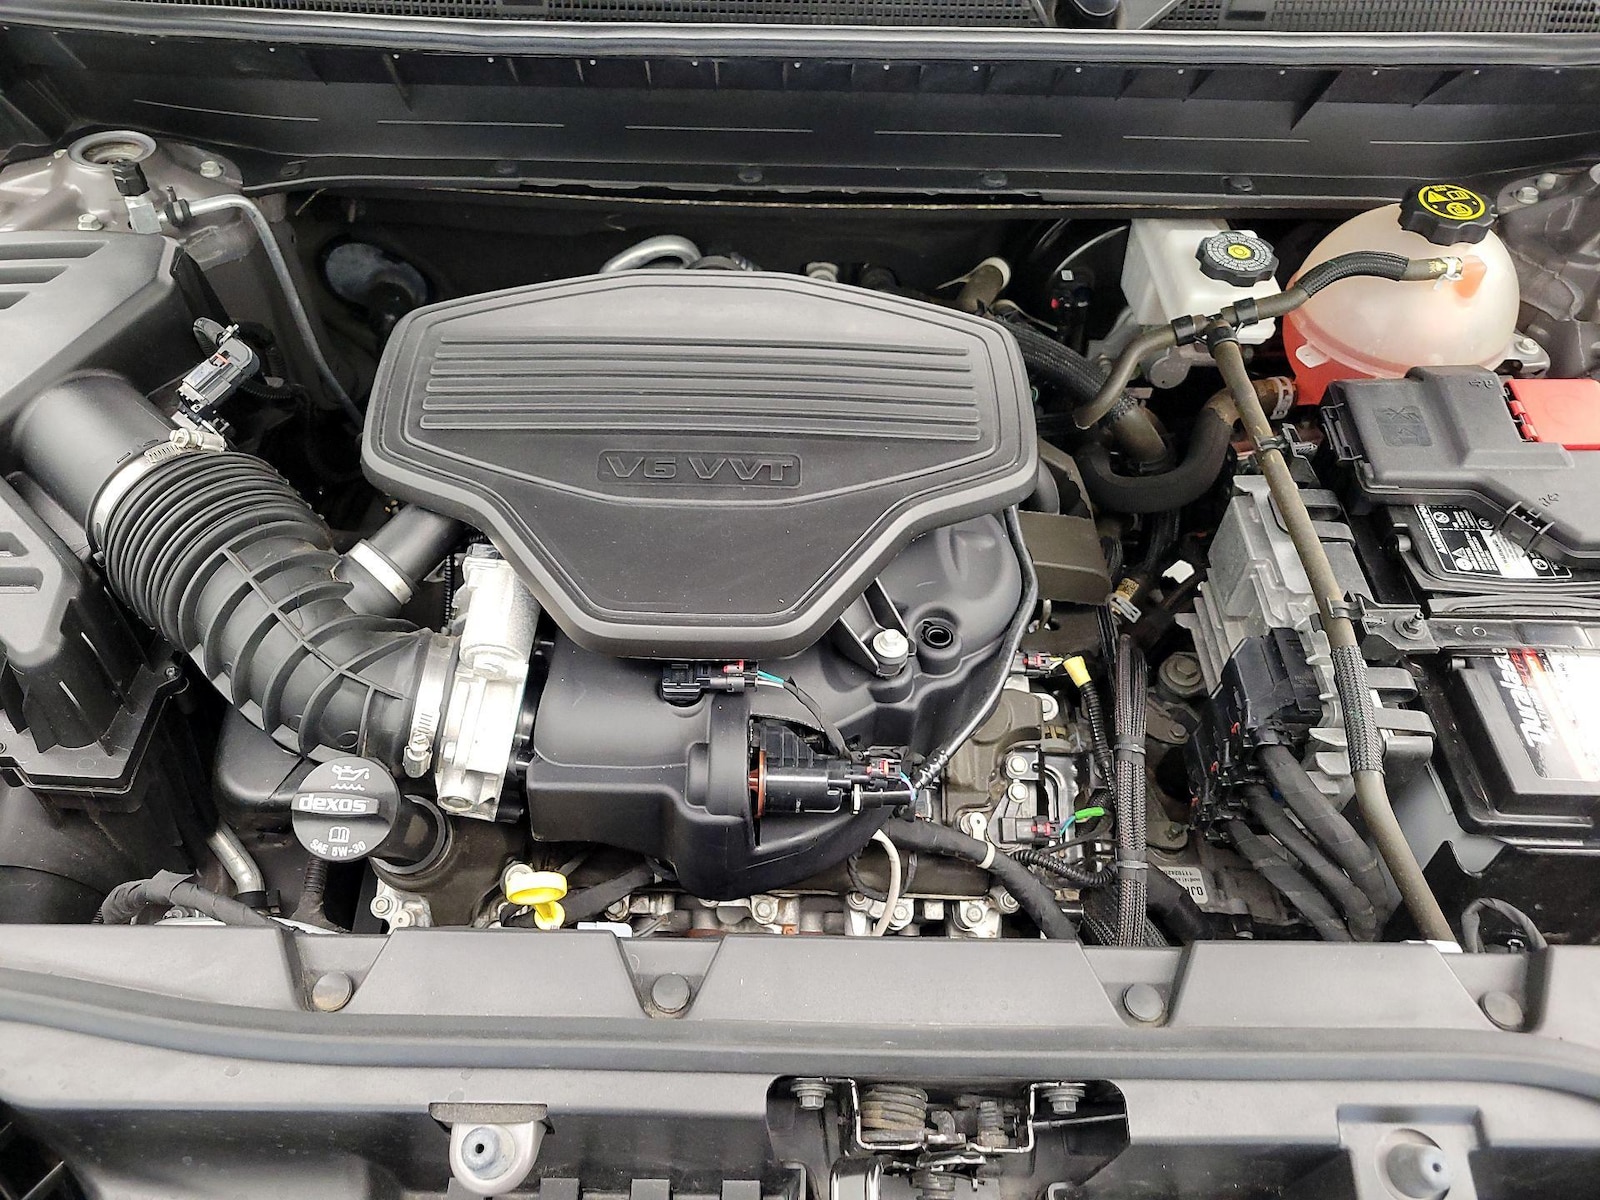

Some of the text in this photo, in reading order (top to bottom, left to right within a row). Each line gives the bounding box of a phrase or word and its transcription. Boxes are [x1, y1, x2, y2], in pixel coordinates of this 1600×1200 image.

[605, 456, 793, 481] V6 VVT
[298, 793, 367, 812] dexos
[310, 838, 329, 855] SAE
